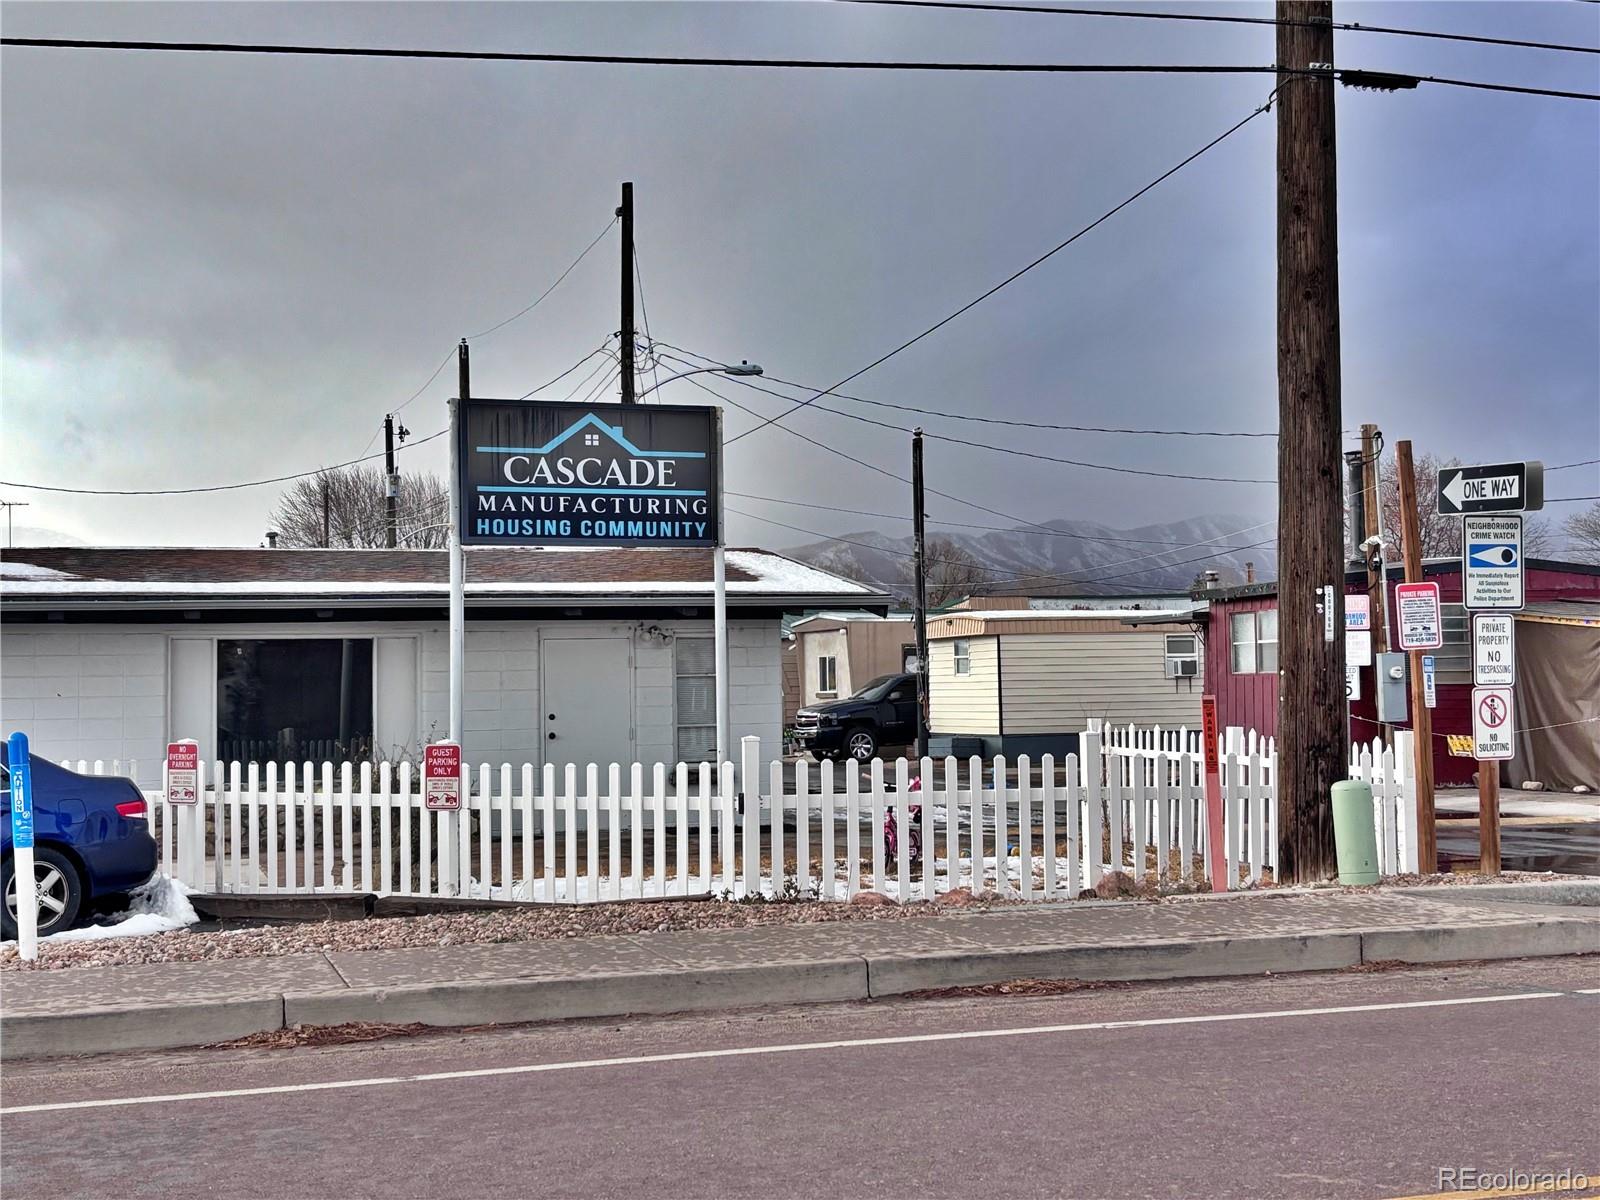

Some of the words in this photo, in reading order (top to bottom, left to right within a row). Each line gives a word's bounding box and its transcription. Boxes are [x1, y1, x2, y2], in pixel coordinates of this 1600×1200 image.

[503, 456, 677, 487] CASCADE
[1463, 480, 1487, 499] ONE
[1491, 478, 1516, 497] WAY
[478, 495, 707, 515] MANUFACTURING
[477, 518, 571, 536] HOUSING
[581, 520, 707, 538] COMMUNITY
[1467, 522, 1519, 530] NEIGHBORHOOD
[1470, 532, 1492, 540] CRIME
[1493, 532, 1516, 540] WATCH
[1481, 622, 1506, 633] PRIVATE
[1478, 635, 1510, 646] PROPERTY
[1487, 650, 1501, 663] NO
[1478, 664, 1512, 674] TRESPASSING
[1206, 711, 1214, 760] WARNING
[1489, 733, 1498, 742] NO
[432, 748, 454, 757] GUEST
[1478, 743, 1510, 752] SOLICITING
[428, 757, 458, 766] PARKING
[433, 767, 452, 776] ONLY
